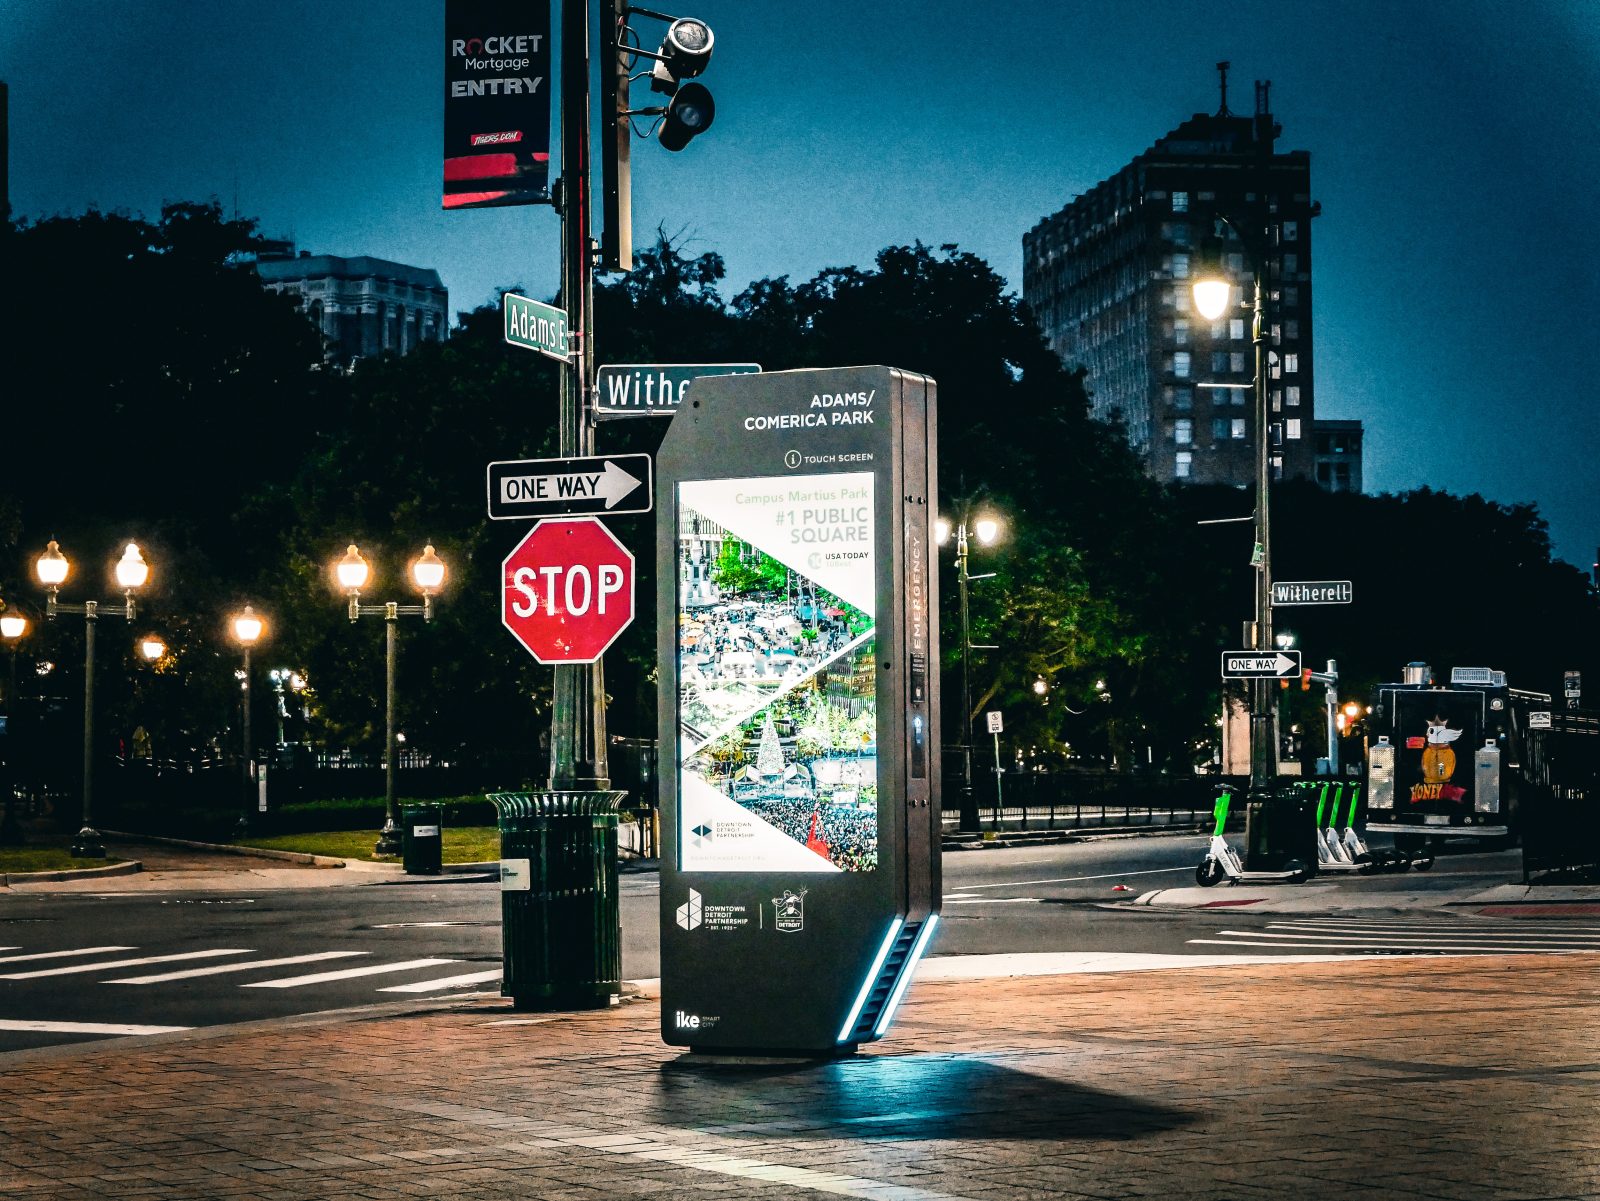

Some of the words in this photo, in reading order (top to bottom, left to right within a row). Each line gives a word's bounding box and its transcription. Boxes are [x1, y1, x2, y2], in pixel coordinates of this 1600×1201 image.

[452, 34, 543, 57] ROCKET
[465, 57, 530, 71] Mortgage
[451, 76, 543, 98] ENTRY
[474, 131, 518, 146] TIGERS.COM
[510, 304, 556, 348] Adams
[559, 319, 565, 351] E
[810, 389, 876, 408] ADAMS/
[744, 413, 827, 431] COMERICA
[831, 410, 875, 426] PARK
[804, 454, 836, 464] TOUCH
[838, 452, 874, 463] SCREEN
[506, 477, 549, 500] ONE
[557, 475, 601, 498] WAY
[735, 491, 784, 506] Campus
[788, 489, 837, 503] Martius
[841, 486, 868, 500] Park
[775, 509, 795, 526] #1
[803, 507, 868, 524] PUBLIC
[791, 526, 868, 544] SQUARE
[512, 564, 625, 618] STOP
[913, 537, 921, 650] EMERGENCY
[1277, 585, 1348, 602] Witherell
[1230, 658, 1252, 670] ONE
[1255, 658, 1278, 669] WAY
[676, 1010, 700, 1029] ike
